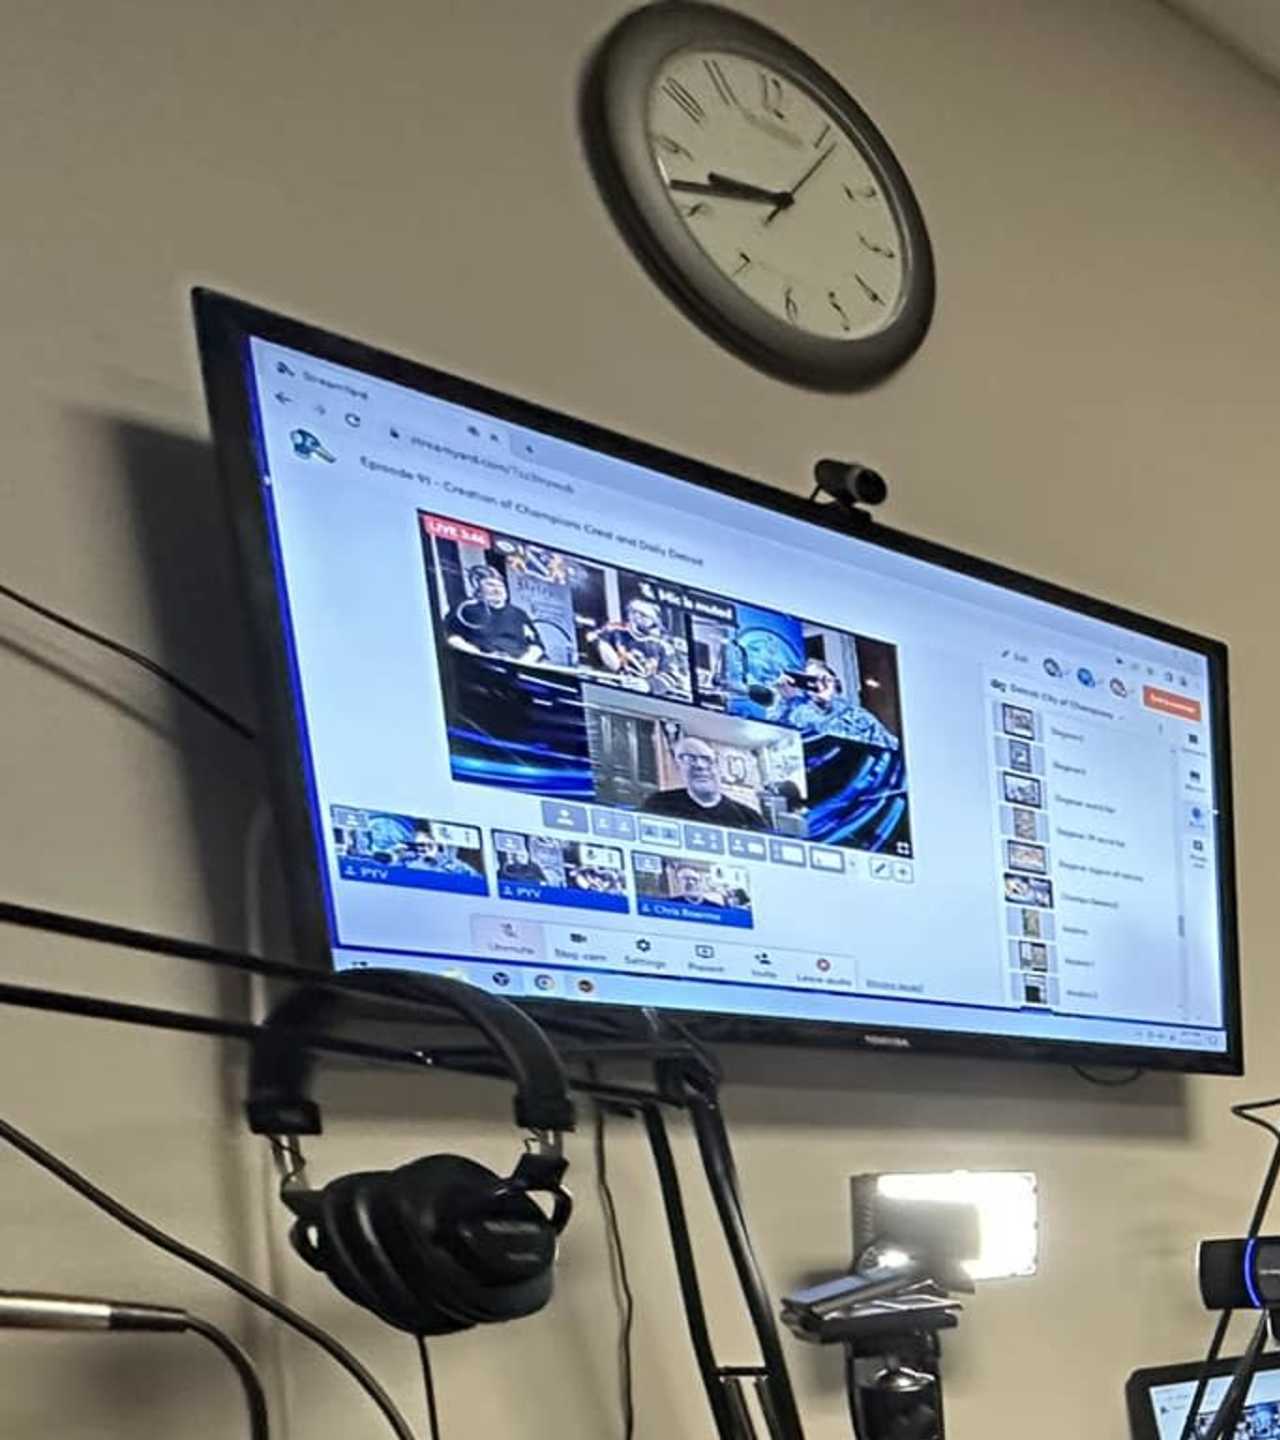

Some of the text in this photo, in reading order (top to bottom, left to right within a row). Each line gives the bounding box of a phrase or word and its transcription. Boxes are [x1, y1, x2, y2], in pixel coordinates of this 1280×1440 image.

[445, 479, 498, 508] Creation
[500, 495, 513, 512] of
[429, 518, 457, 538] LIVE
